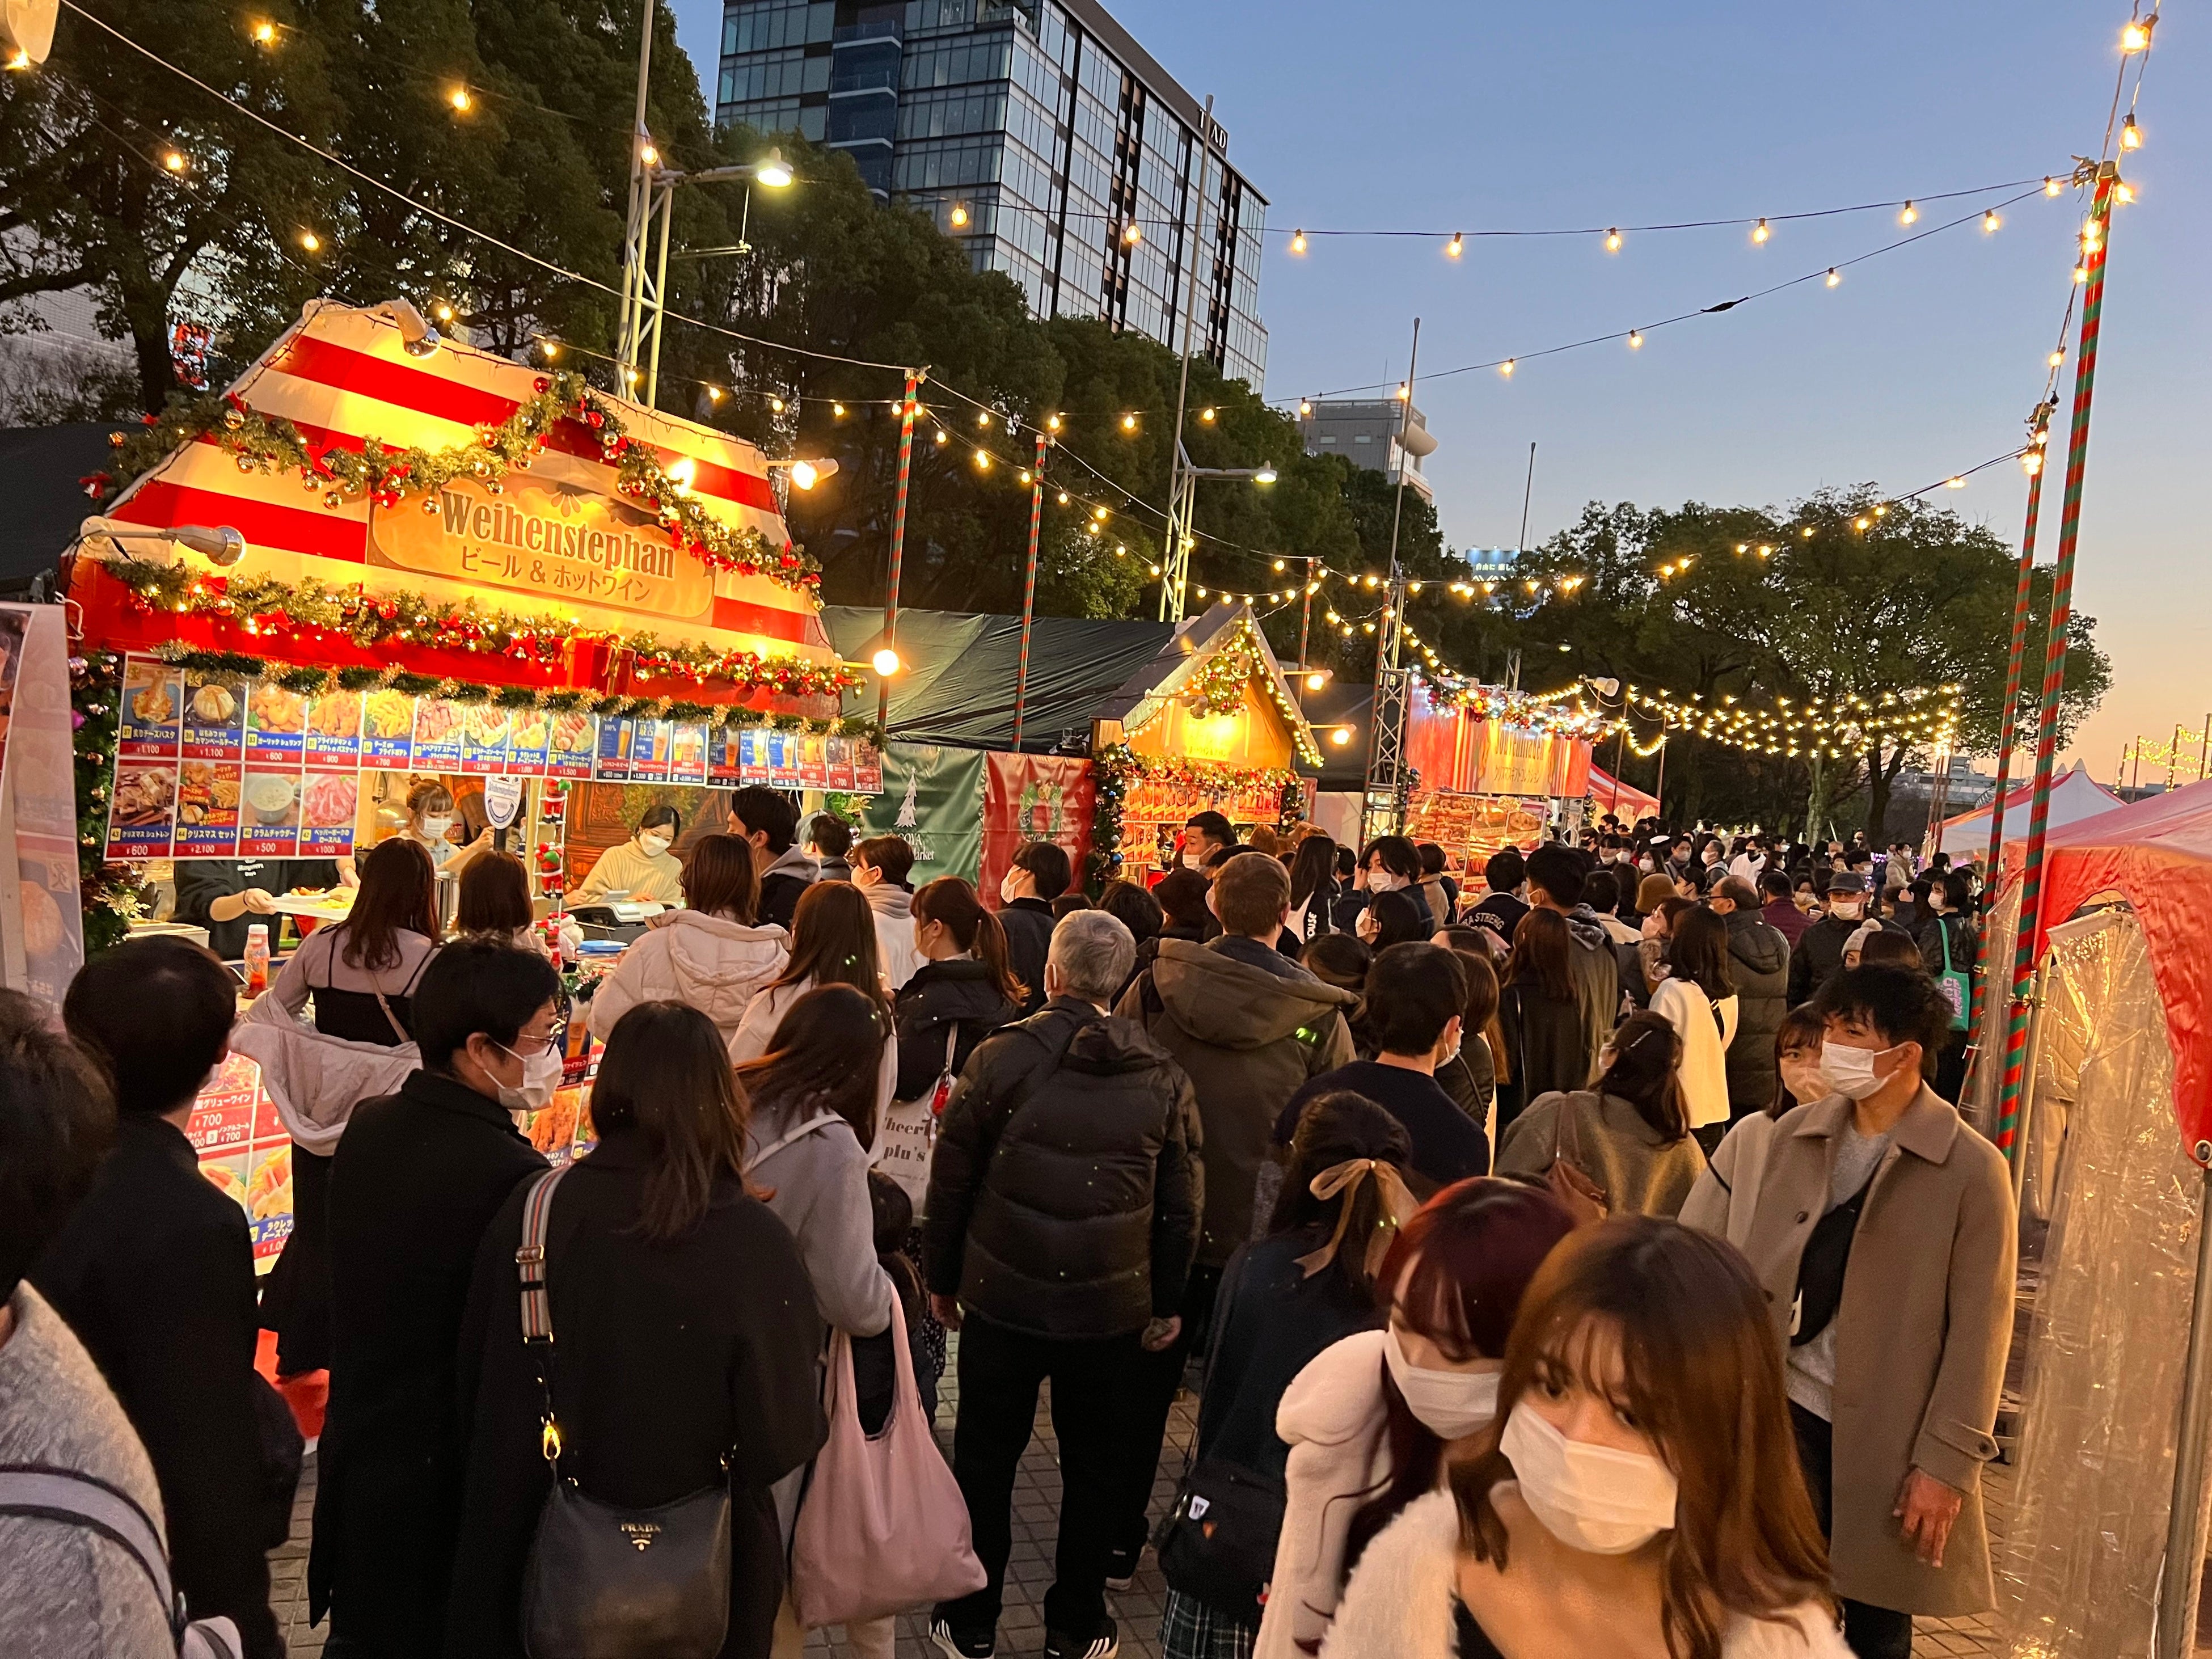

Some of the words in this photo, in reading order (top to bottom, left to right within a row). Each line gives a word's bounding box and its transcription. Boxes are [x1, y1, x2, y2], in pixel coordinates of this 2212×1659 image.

[1199, 108, 1226, 149] TAD
[442, 492, 674, 578] Weihenstephan
[462, 547, 521, 579] ビール
[530, 560, 546, 583] &
[554, 566, 652, 602] ホットワイン
[188, 830, 217, 839] クリスマス
[218, 830, 236, 839] セット
[254, 828, 296, 838] クラムチャウダー
[1306, 911, 1318, 939] OUSE
[196, 1112, 222, 1128] ¥700
[218, 1122, 250, 1133] ノンアルコール
[883, 1144, 926, 1163] plu's
[621, 1523, 662, 1533] PRADA
